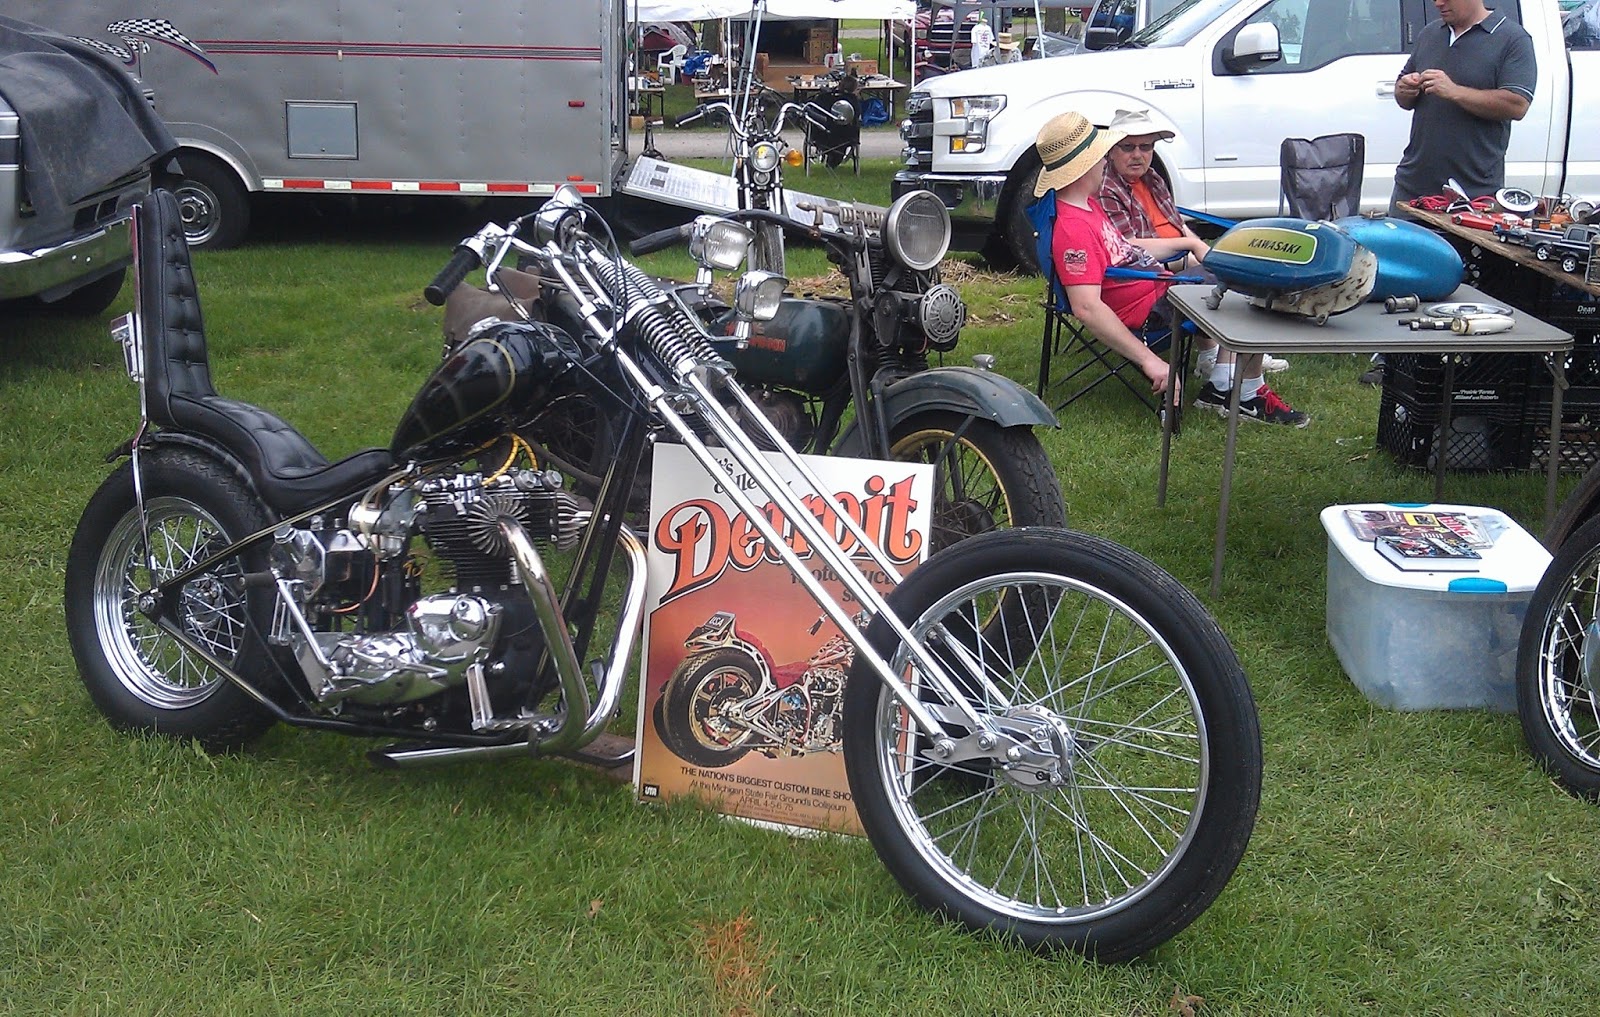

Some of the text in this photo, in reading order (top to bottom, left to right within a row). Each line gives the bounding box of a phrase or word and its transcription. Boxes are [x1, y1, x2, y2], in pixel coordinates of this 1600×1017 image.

[1248, 238, 1302, 254] KAWASAKI
[709, 616, 725, 627] USA
[680, 767, 852, 801] THE NATION'S BIGGEST CUSTOM BIKE SHO
[711, 783, 744, 795] Michigan
[745, 788, 764, 798] State
[764, 791, 778, 800] Fair
[779, 793, 812, 806] Grounds
[812, 799, 848, 812] Coliseum
